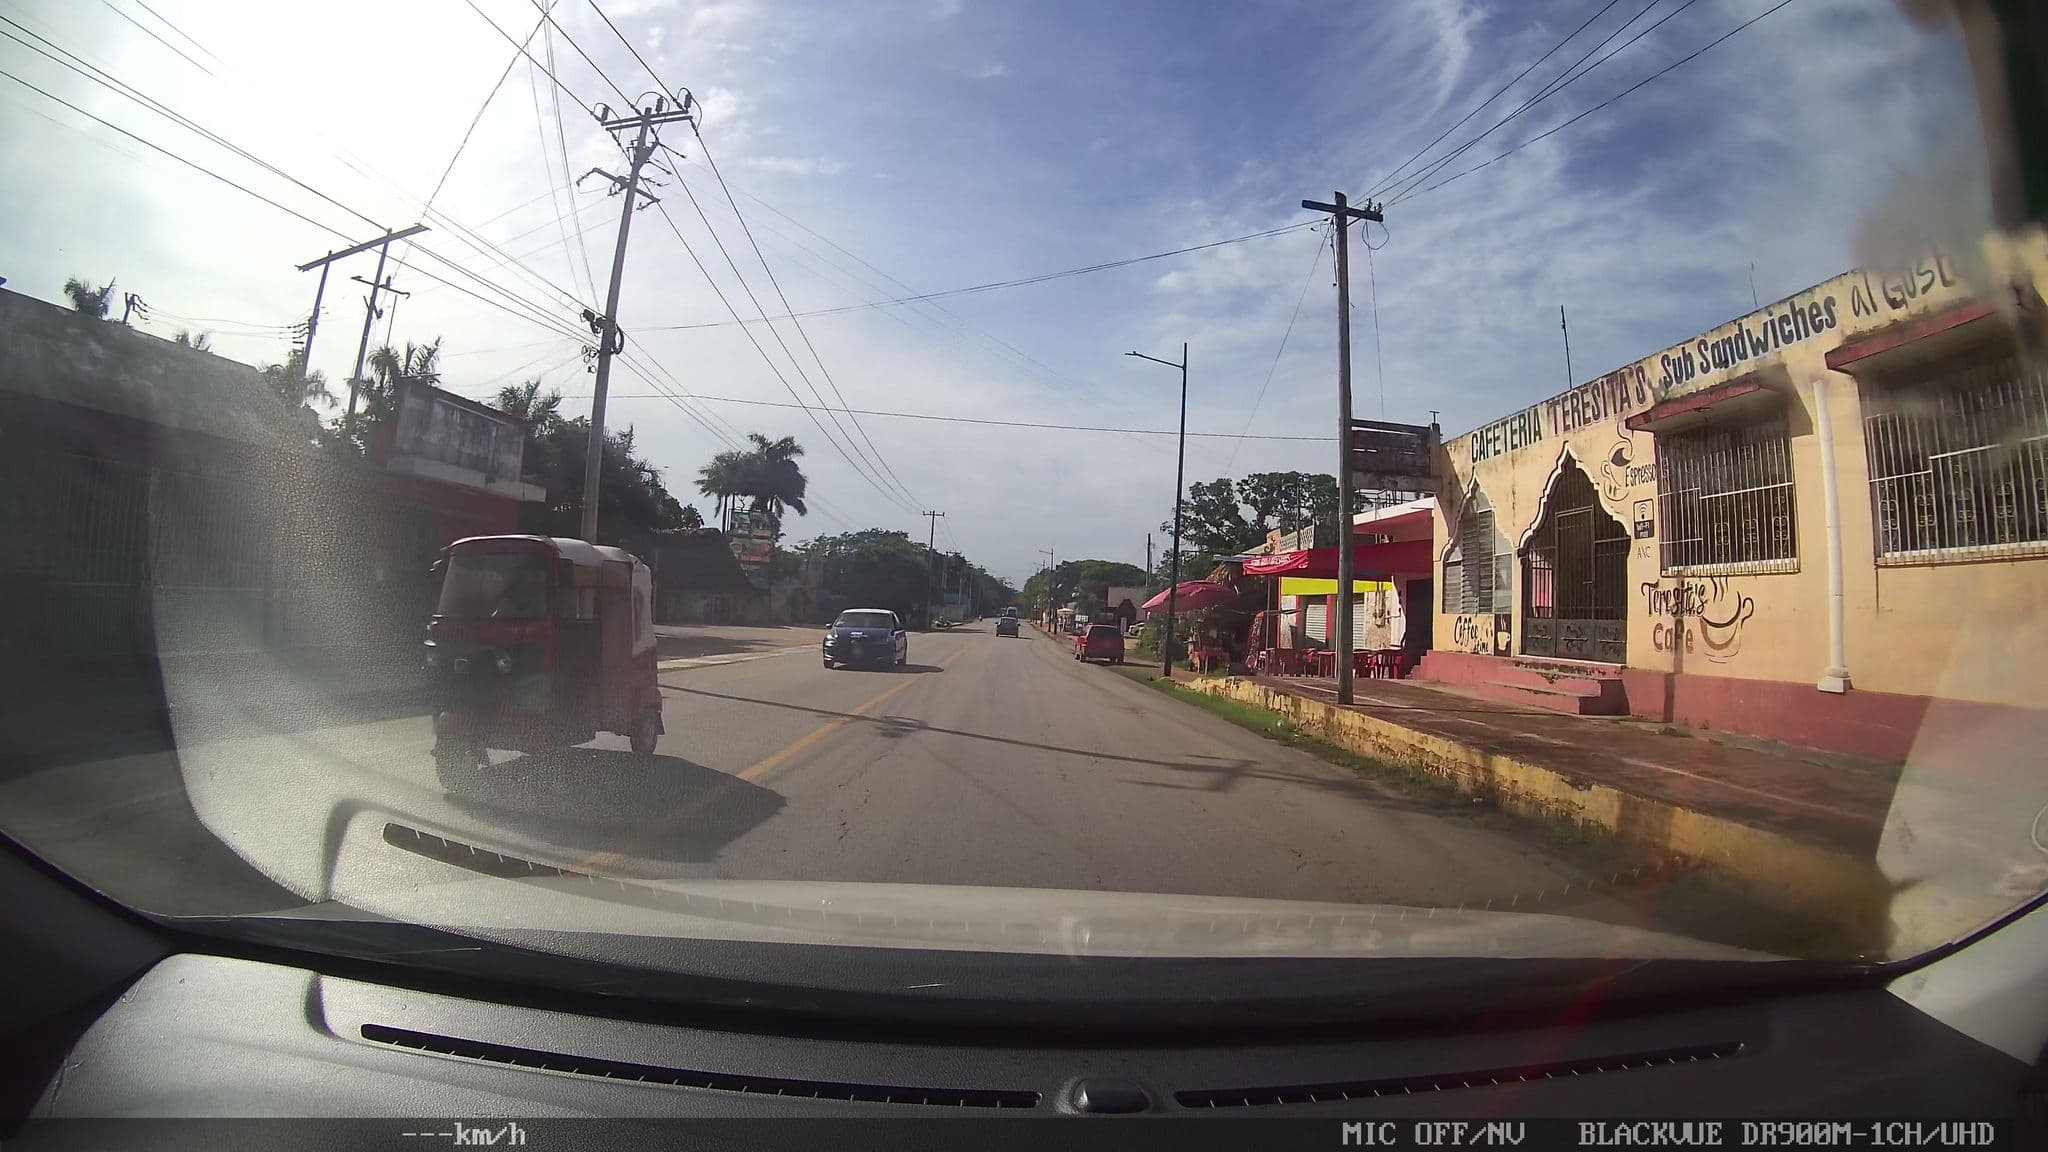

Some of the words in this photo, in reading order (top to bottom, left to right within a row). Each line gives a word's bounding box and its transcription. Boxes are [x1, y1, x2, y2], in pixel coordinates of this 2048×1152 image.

[1661, 347, 1696, 388] Sub
[1697, 296, 1837, 375] Sandwiches
[1471, 407, 1542, 464] CAFETERIA
[1550, 365, 1647, 435] TERESITA'S
[1625, 463, 1657, 487] Espresso
[1454, 616, 1479, 647] Coffee
